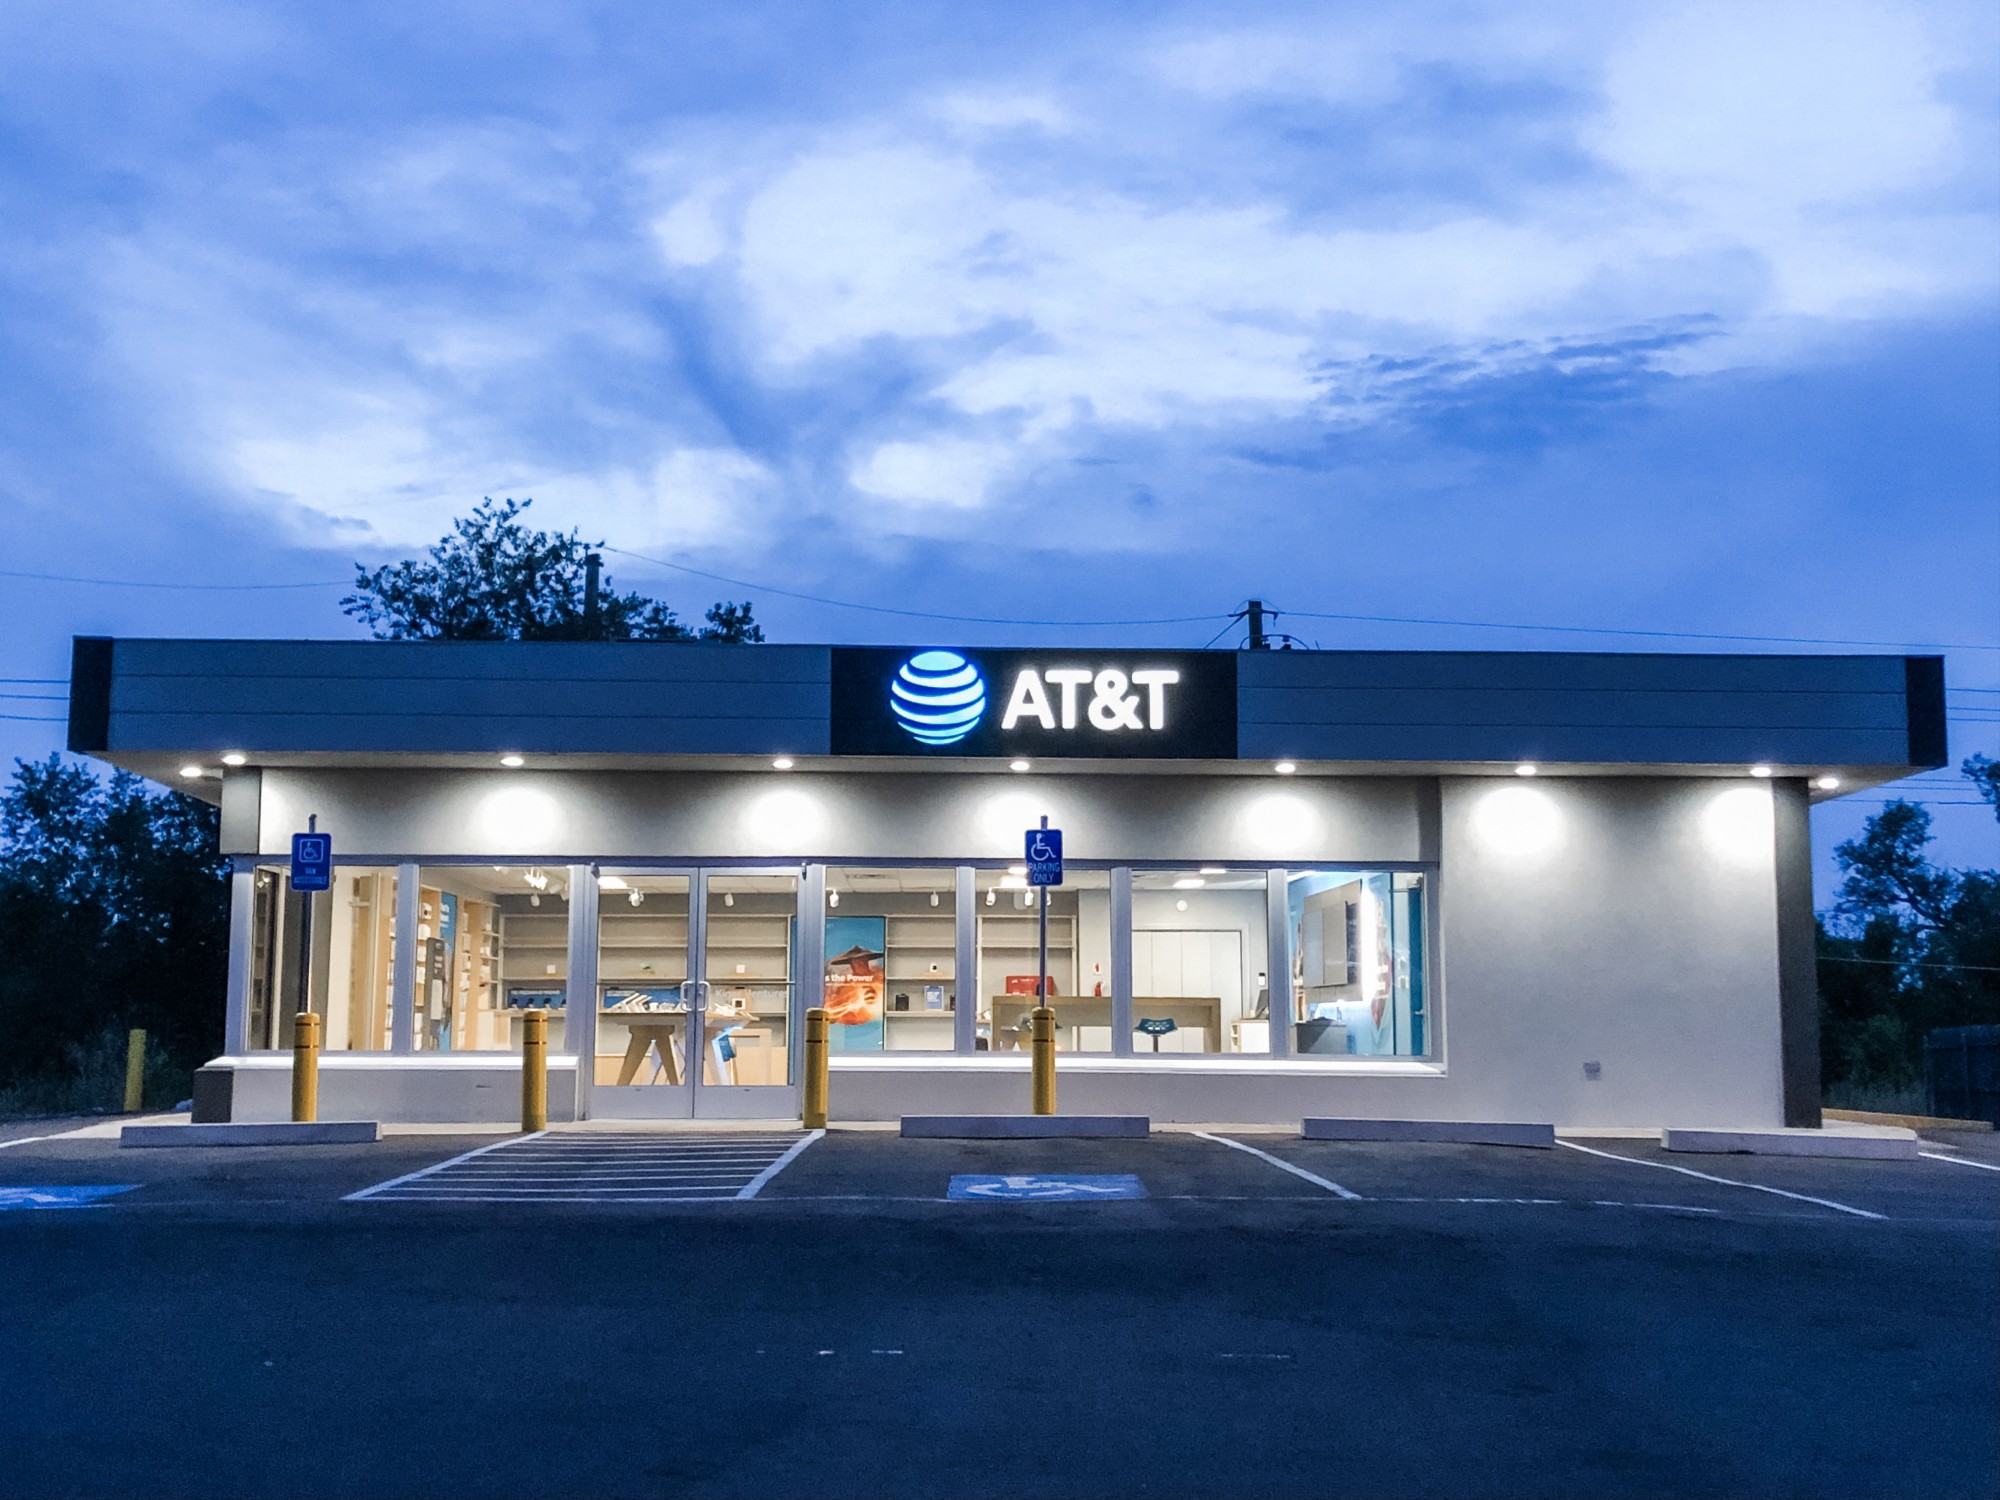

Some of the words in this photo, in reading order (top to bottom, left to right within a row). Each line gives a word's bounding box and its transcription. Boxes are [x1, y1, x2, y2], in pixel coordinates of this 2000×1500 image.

[1000, 669, 1180, 731] AT&T
[1028, 862, 1060, 873] PARKING
[1033, 873, 1054, 883] ONLY
[831, 974, 846, 982] the
[847, 974, 874, 982] Power
